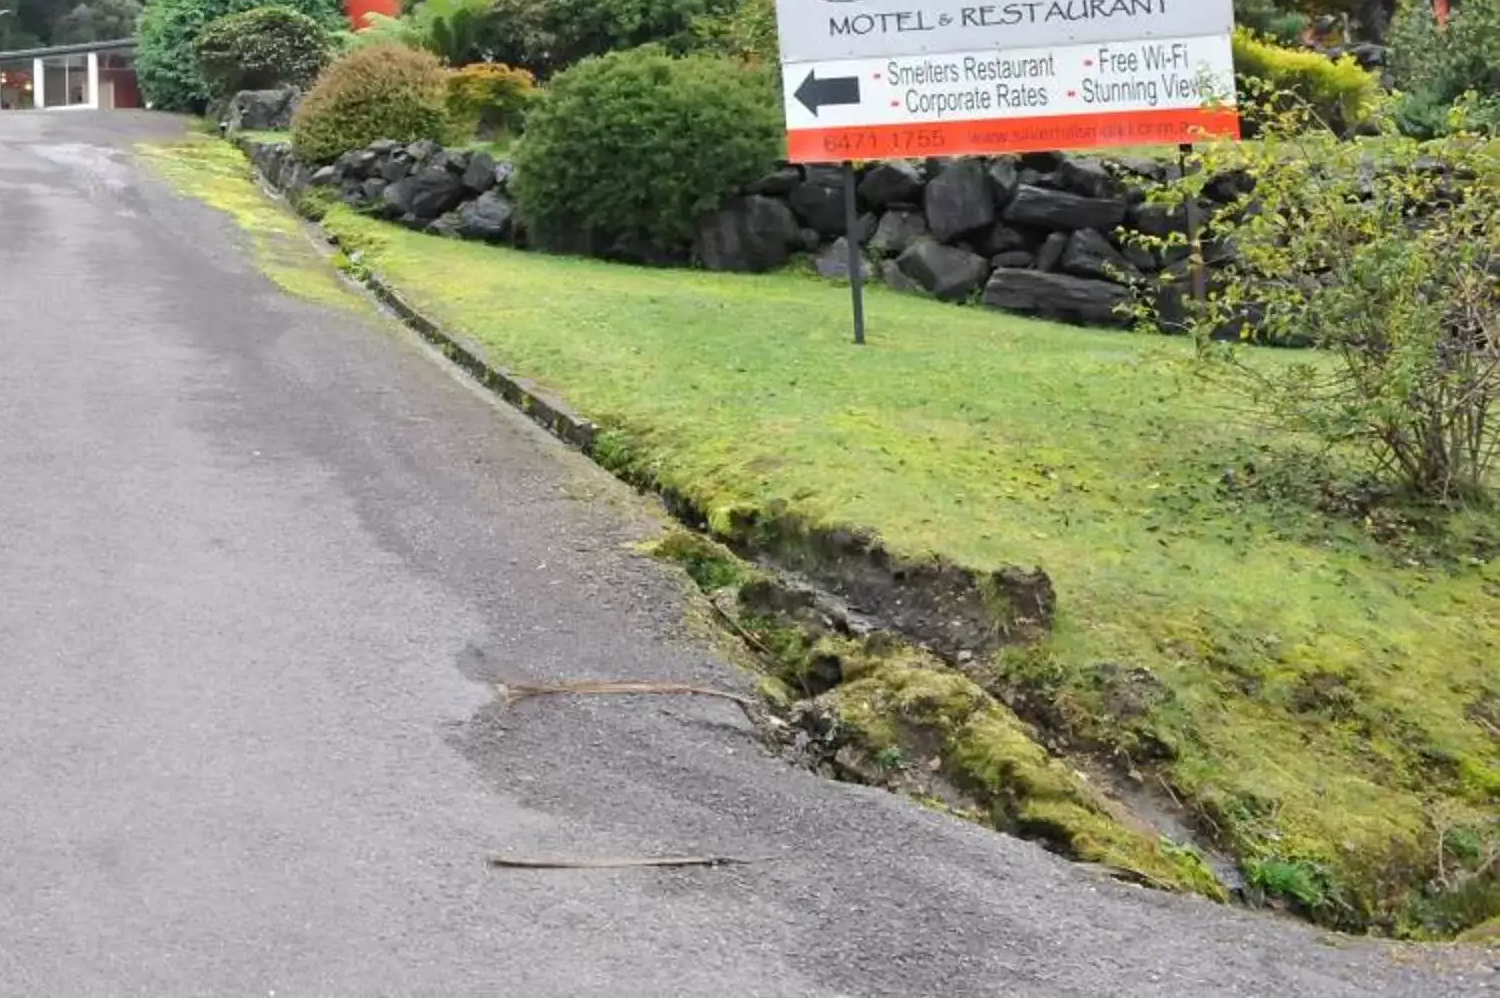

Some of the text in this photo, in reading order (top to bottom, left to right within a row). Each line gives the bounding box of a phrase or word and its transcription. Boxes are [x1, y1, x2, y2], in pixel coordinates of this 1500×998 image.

[828, 11, 934, 37] MOTEL
[887, 54, 1056, 86] Smelters Restaurant
[1099, 43, 1189, 74] Free Wi-Fi
[904, 83, 1049, 118] Corporate Rates
[1081, 72, 1214, 106] Stunning Views
[823, 128, 946, 152] 6471 1755
